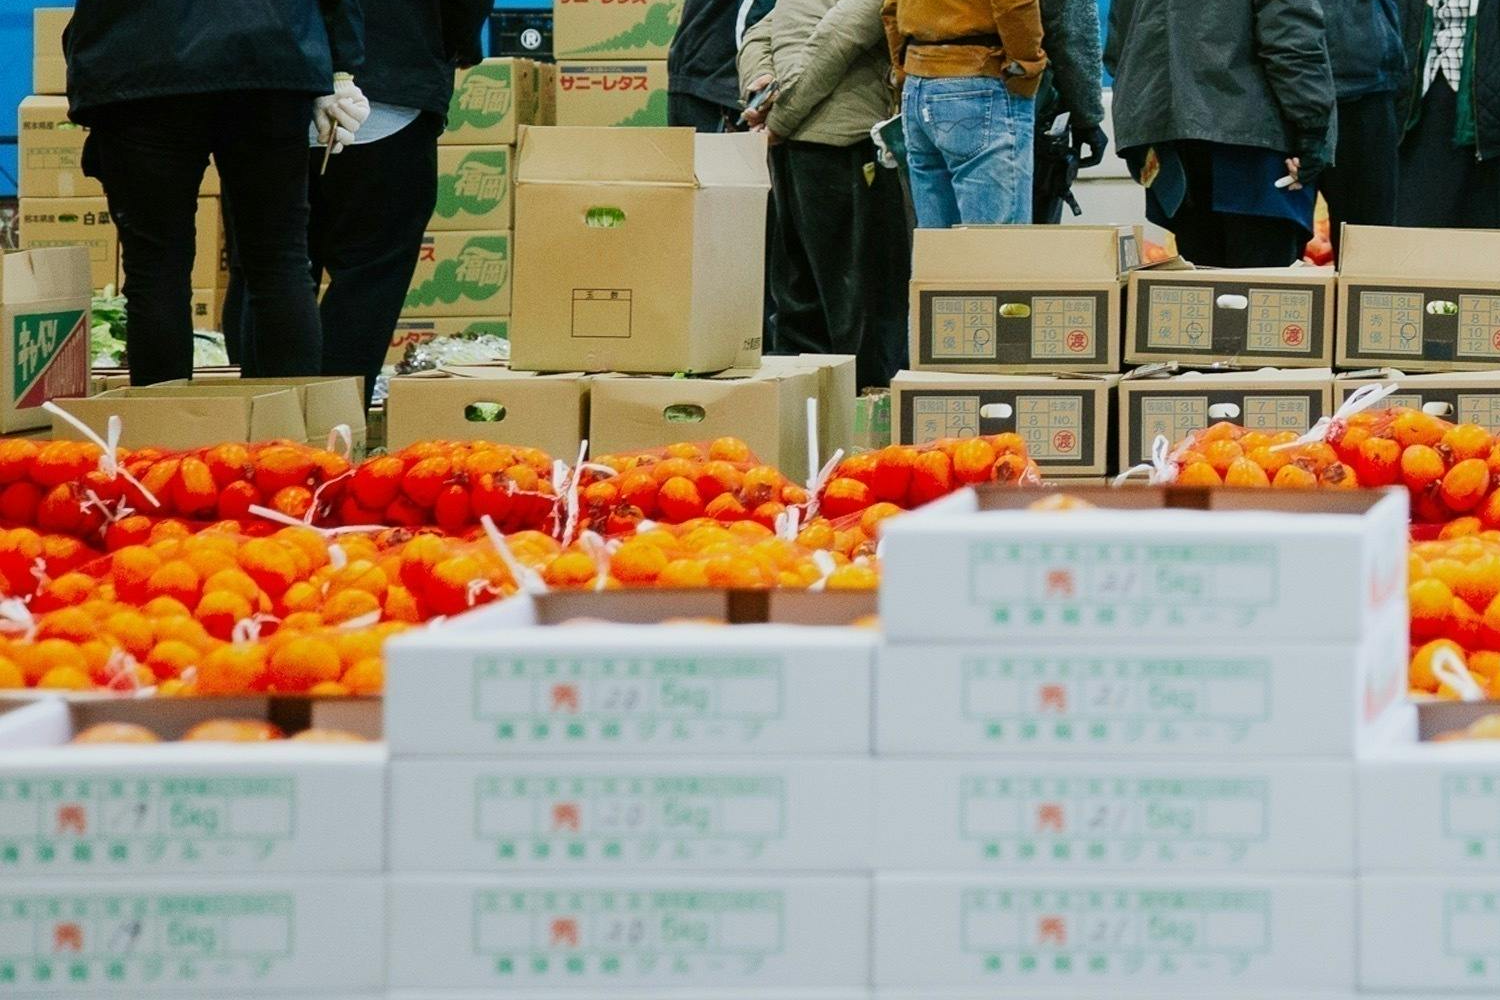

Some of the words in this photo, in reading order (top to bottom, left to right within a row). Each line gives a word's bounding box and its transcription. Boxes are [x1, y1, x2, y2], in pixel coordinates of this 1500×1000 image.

[524, 31, 539, 48] R
[560, 75, 648, 91] サニーレタス
